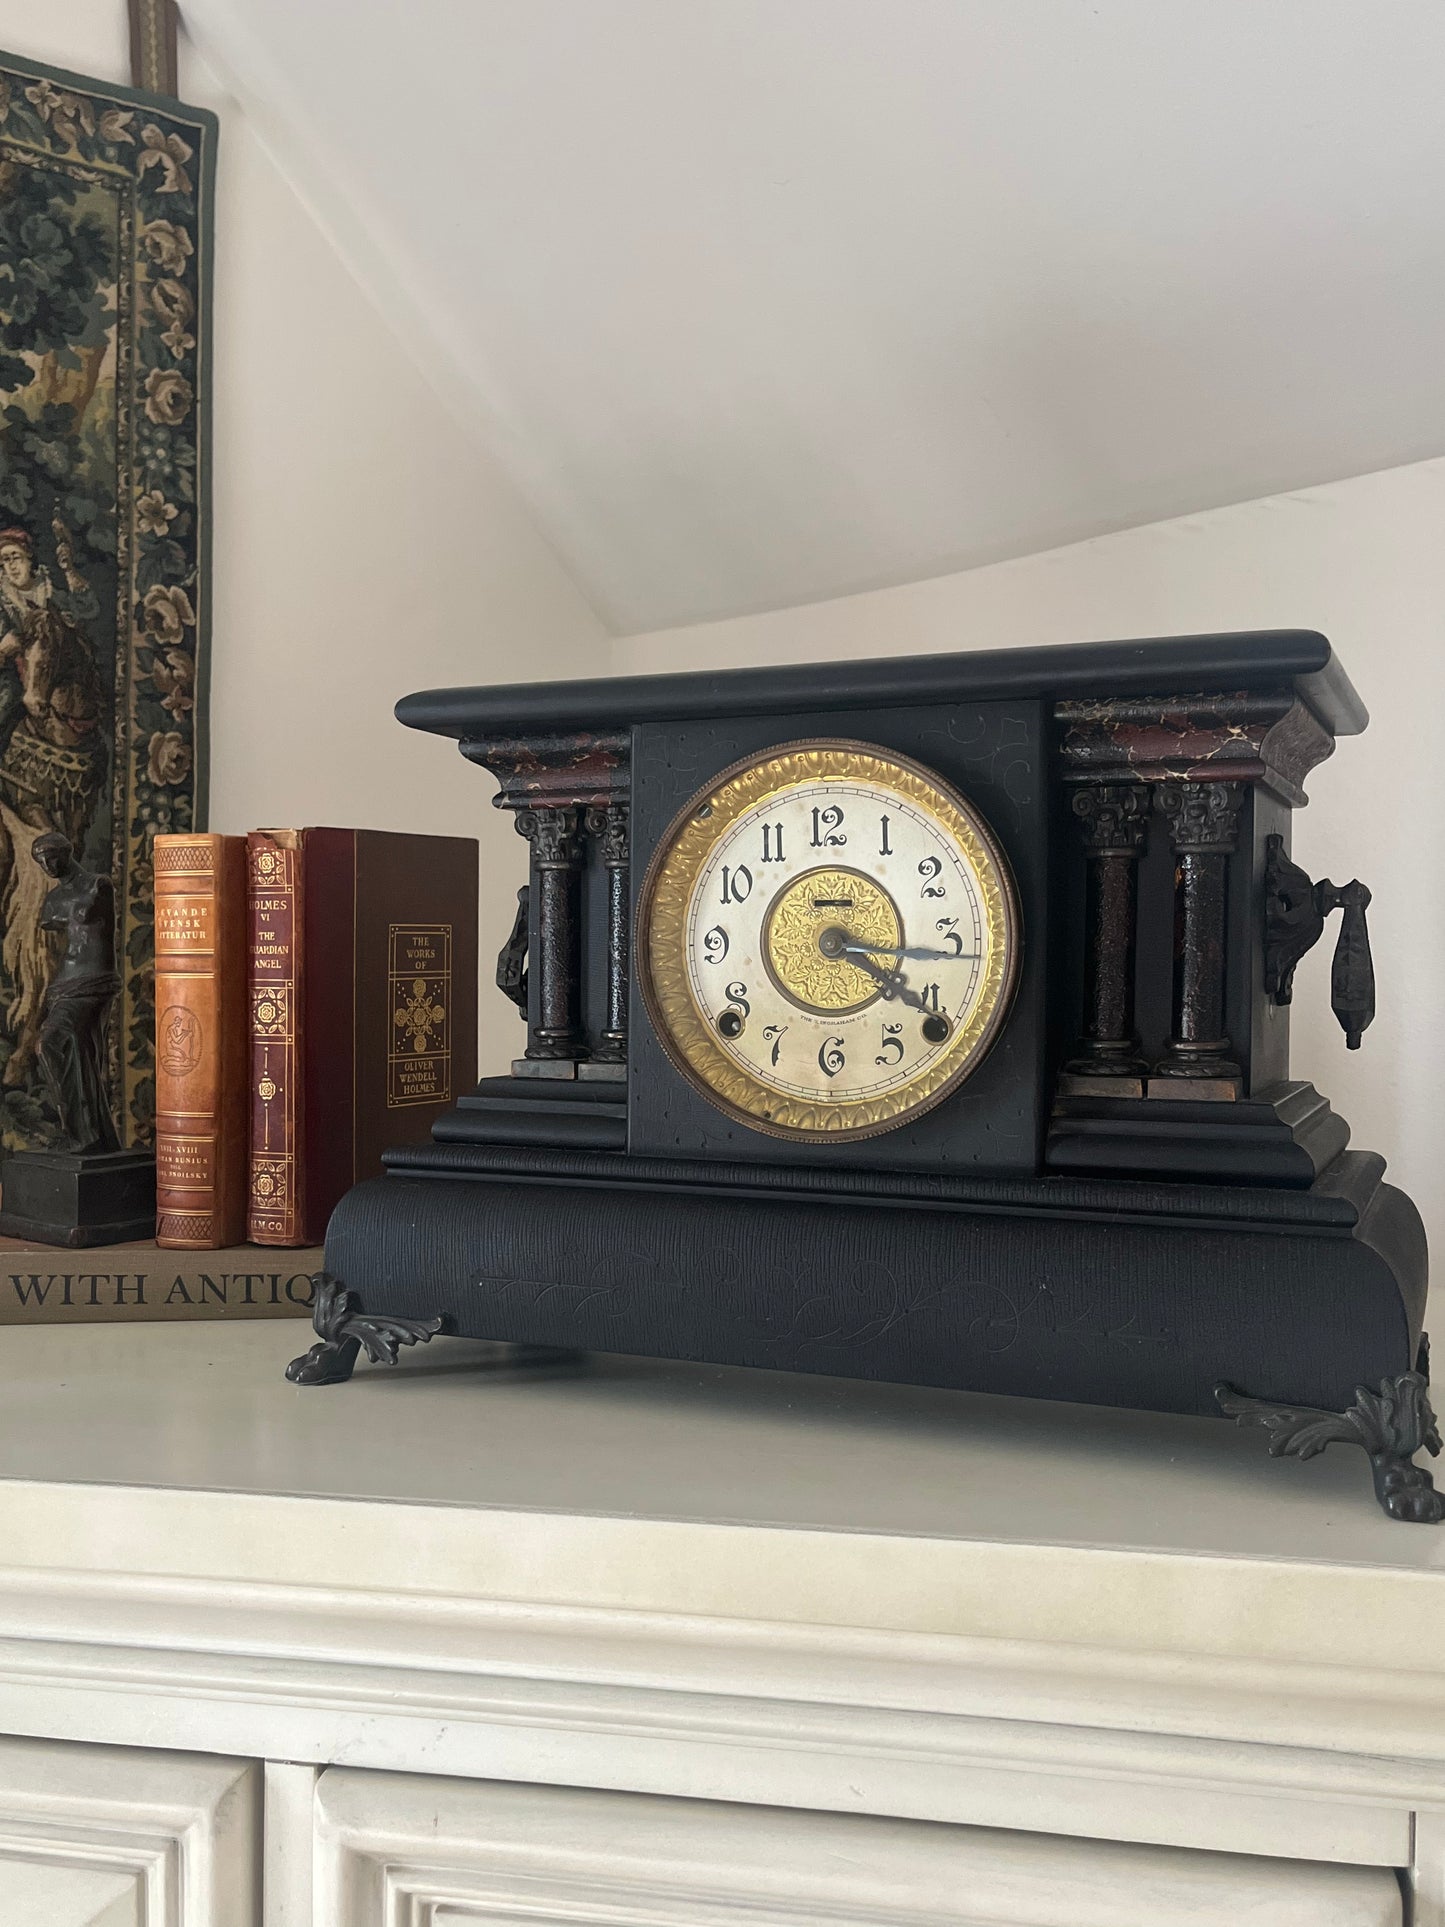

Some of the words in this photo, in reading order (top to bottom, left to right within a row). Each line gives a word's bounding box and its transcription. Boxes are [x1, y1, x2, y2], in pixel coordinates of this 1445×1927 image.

[761, 822, 786, 863] 11
[810, 805, 847, 847] 12
[879, 814, 893, 856] 1
[720, 864, 753, 905] 10
[918, 855, 946, 898] 2
[249, 900, 287, 910] HOLMES
[260, 913, 270, 921] VI
[249, 945, 289, 954] GUARDIAN
[258, 932, 275, 941] THE
[412, 937, 430, 946] THE
[704, 925, 730, 964] 9
[936, 917, 963, 960] 3
[254, 959, 282, 969] ANGEL
[406, 949, 436, 959] WORKS
[415, 961, 427, 970] OF
[725, 981, 750, 1018] 8
[918, 982, 947, 1014] 4
[762, 1025, 789, 1066] 7
[818, 1036, 846, 1078] 6
[875, 1022, 904, 1066] 5
[399, 1072, 437, 1083] WENDELL
[404, 1061, 434, 1071] OLIVER
[403, 1082, 435, 1095] HOLMES
[8, 1274, 148, 1306] WITH
[164, 1273, 315, 1308] ANTIQ
